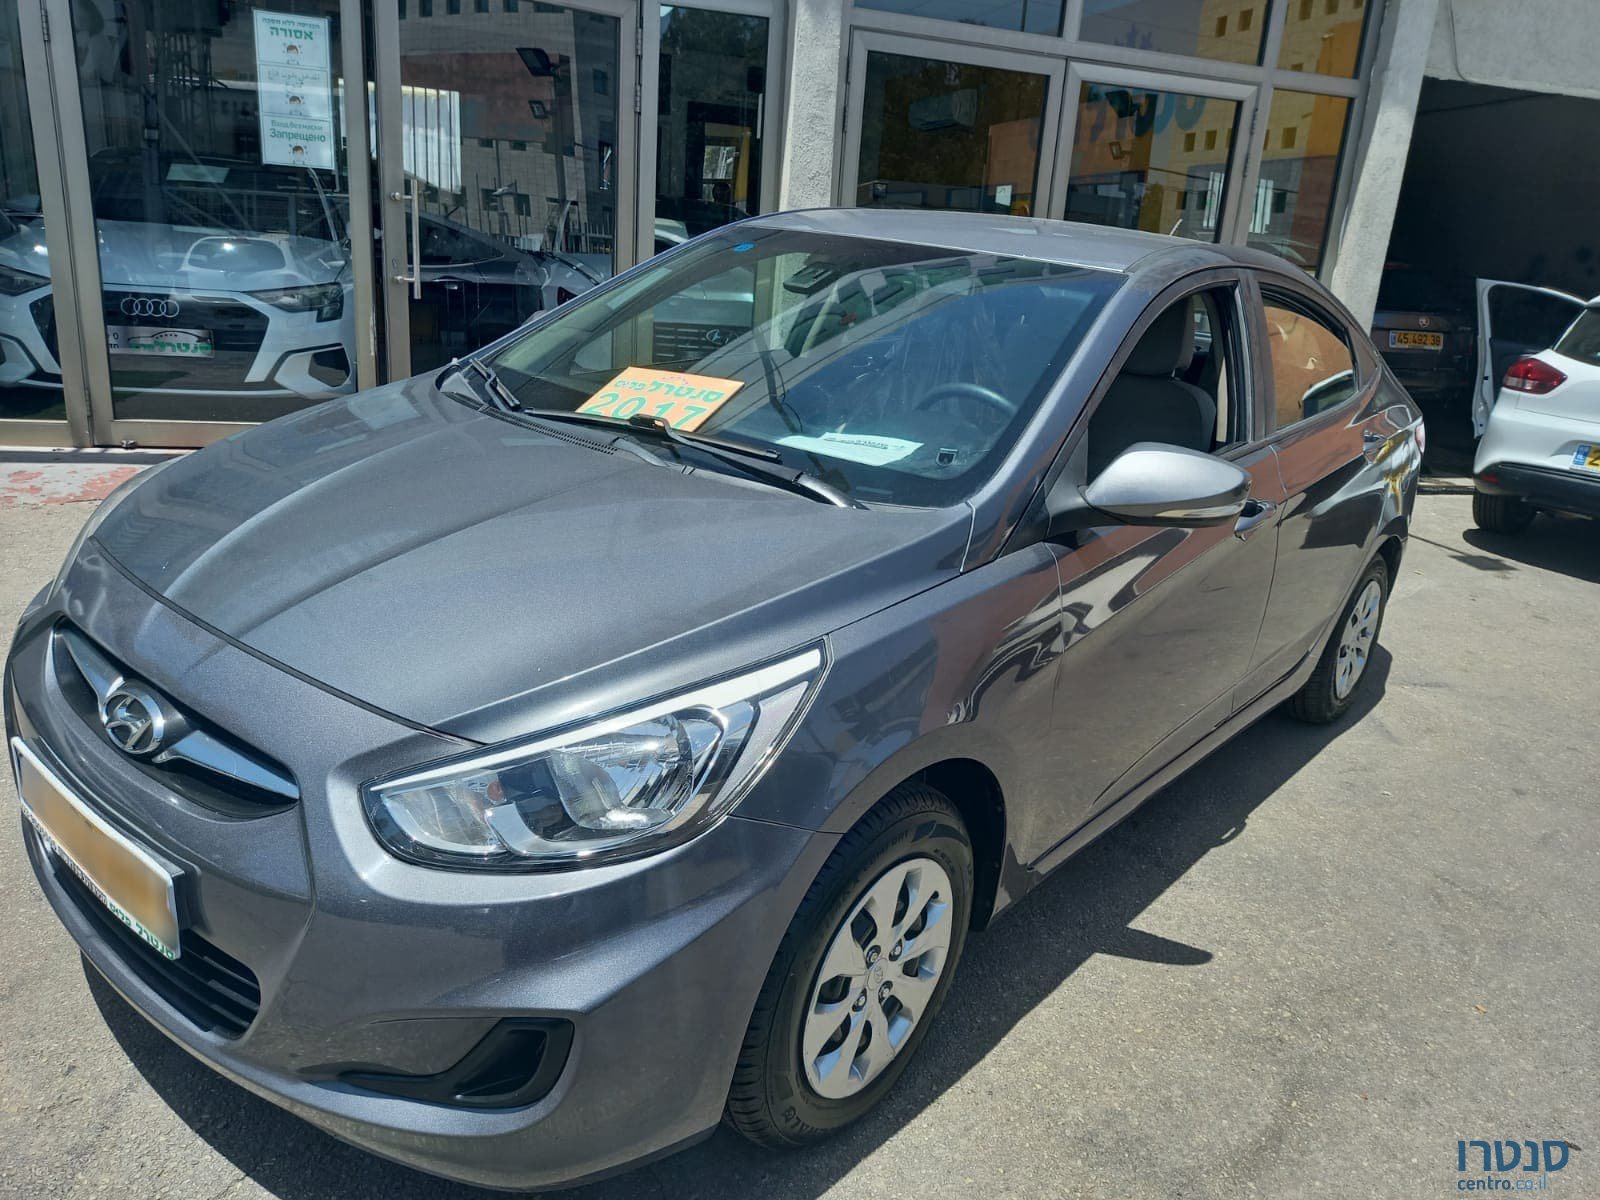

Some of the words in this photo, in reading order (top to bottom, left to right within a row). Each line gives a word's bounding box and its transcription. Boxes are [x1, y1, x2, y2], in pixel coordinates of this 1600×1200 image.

[270, 26, 314, 41] אסורה
[270, 128, 326, 142] Запрещено
[647, 380, 725, 403] סנטרל
[586, 391, 707, 430] 2017
[135, 922, 175, 960] סנטרל
